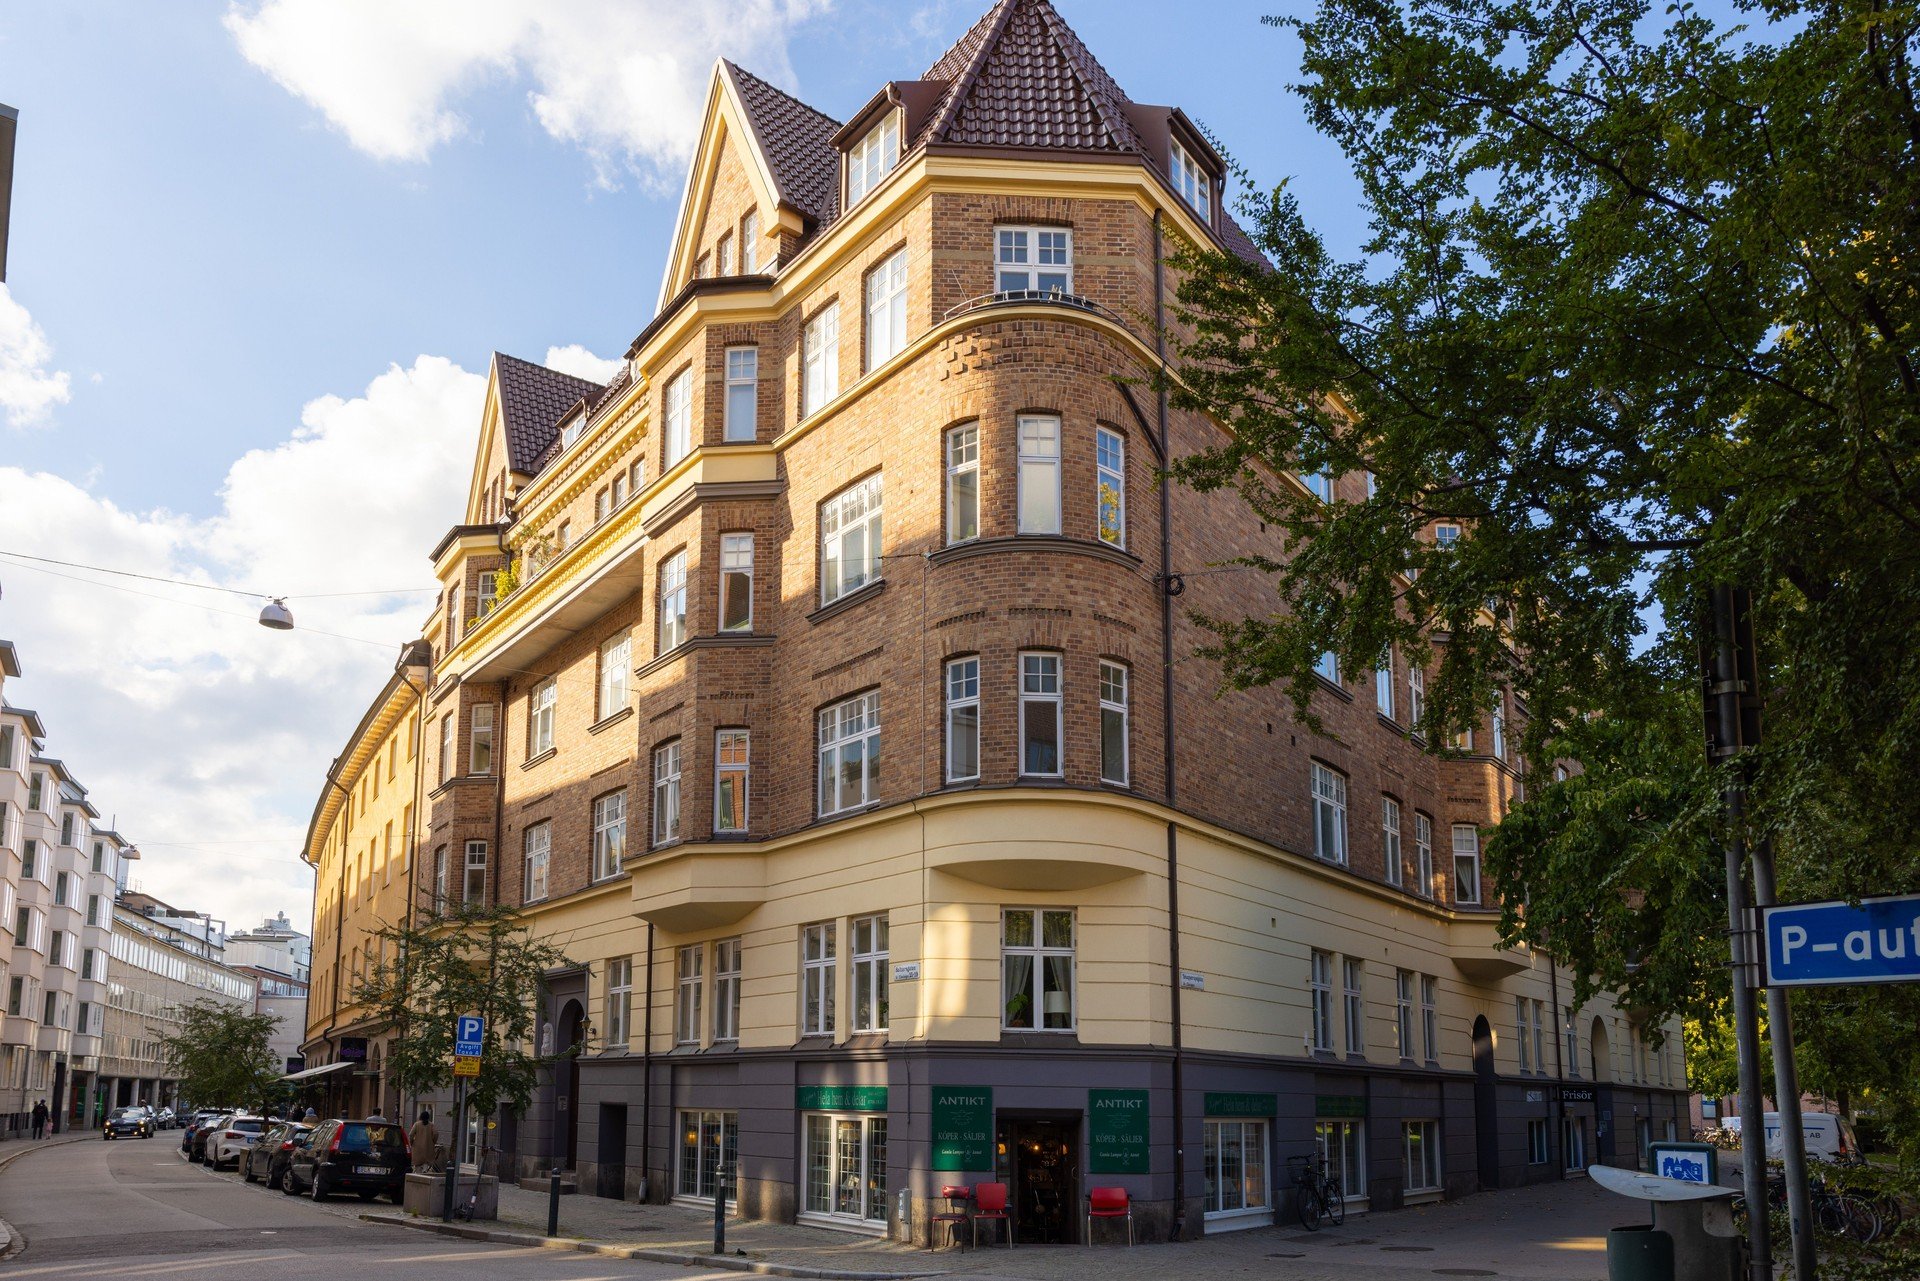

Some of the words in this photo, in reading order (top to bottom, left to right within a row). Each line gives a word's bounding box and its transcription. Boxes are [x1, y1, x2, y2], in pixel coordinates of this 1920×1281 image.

[1781, 915, 1920, 965] P-aut
[464, 1020, 479, 1040] P
[817, 1090, 831, 1106] Hela
[938, 1096, 986, 1105] ANTIKT
[1562, 1090, 1593, 1100] Frisör
[1096, 1099, 1143, 1108] ANTIKT
[963, 1130, 986, 1141] SÄLJER
[1120, 1133, 1144, 1144] SÄLJER
